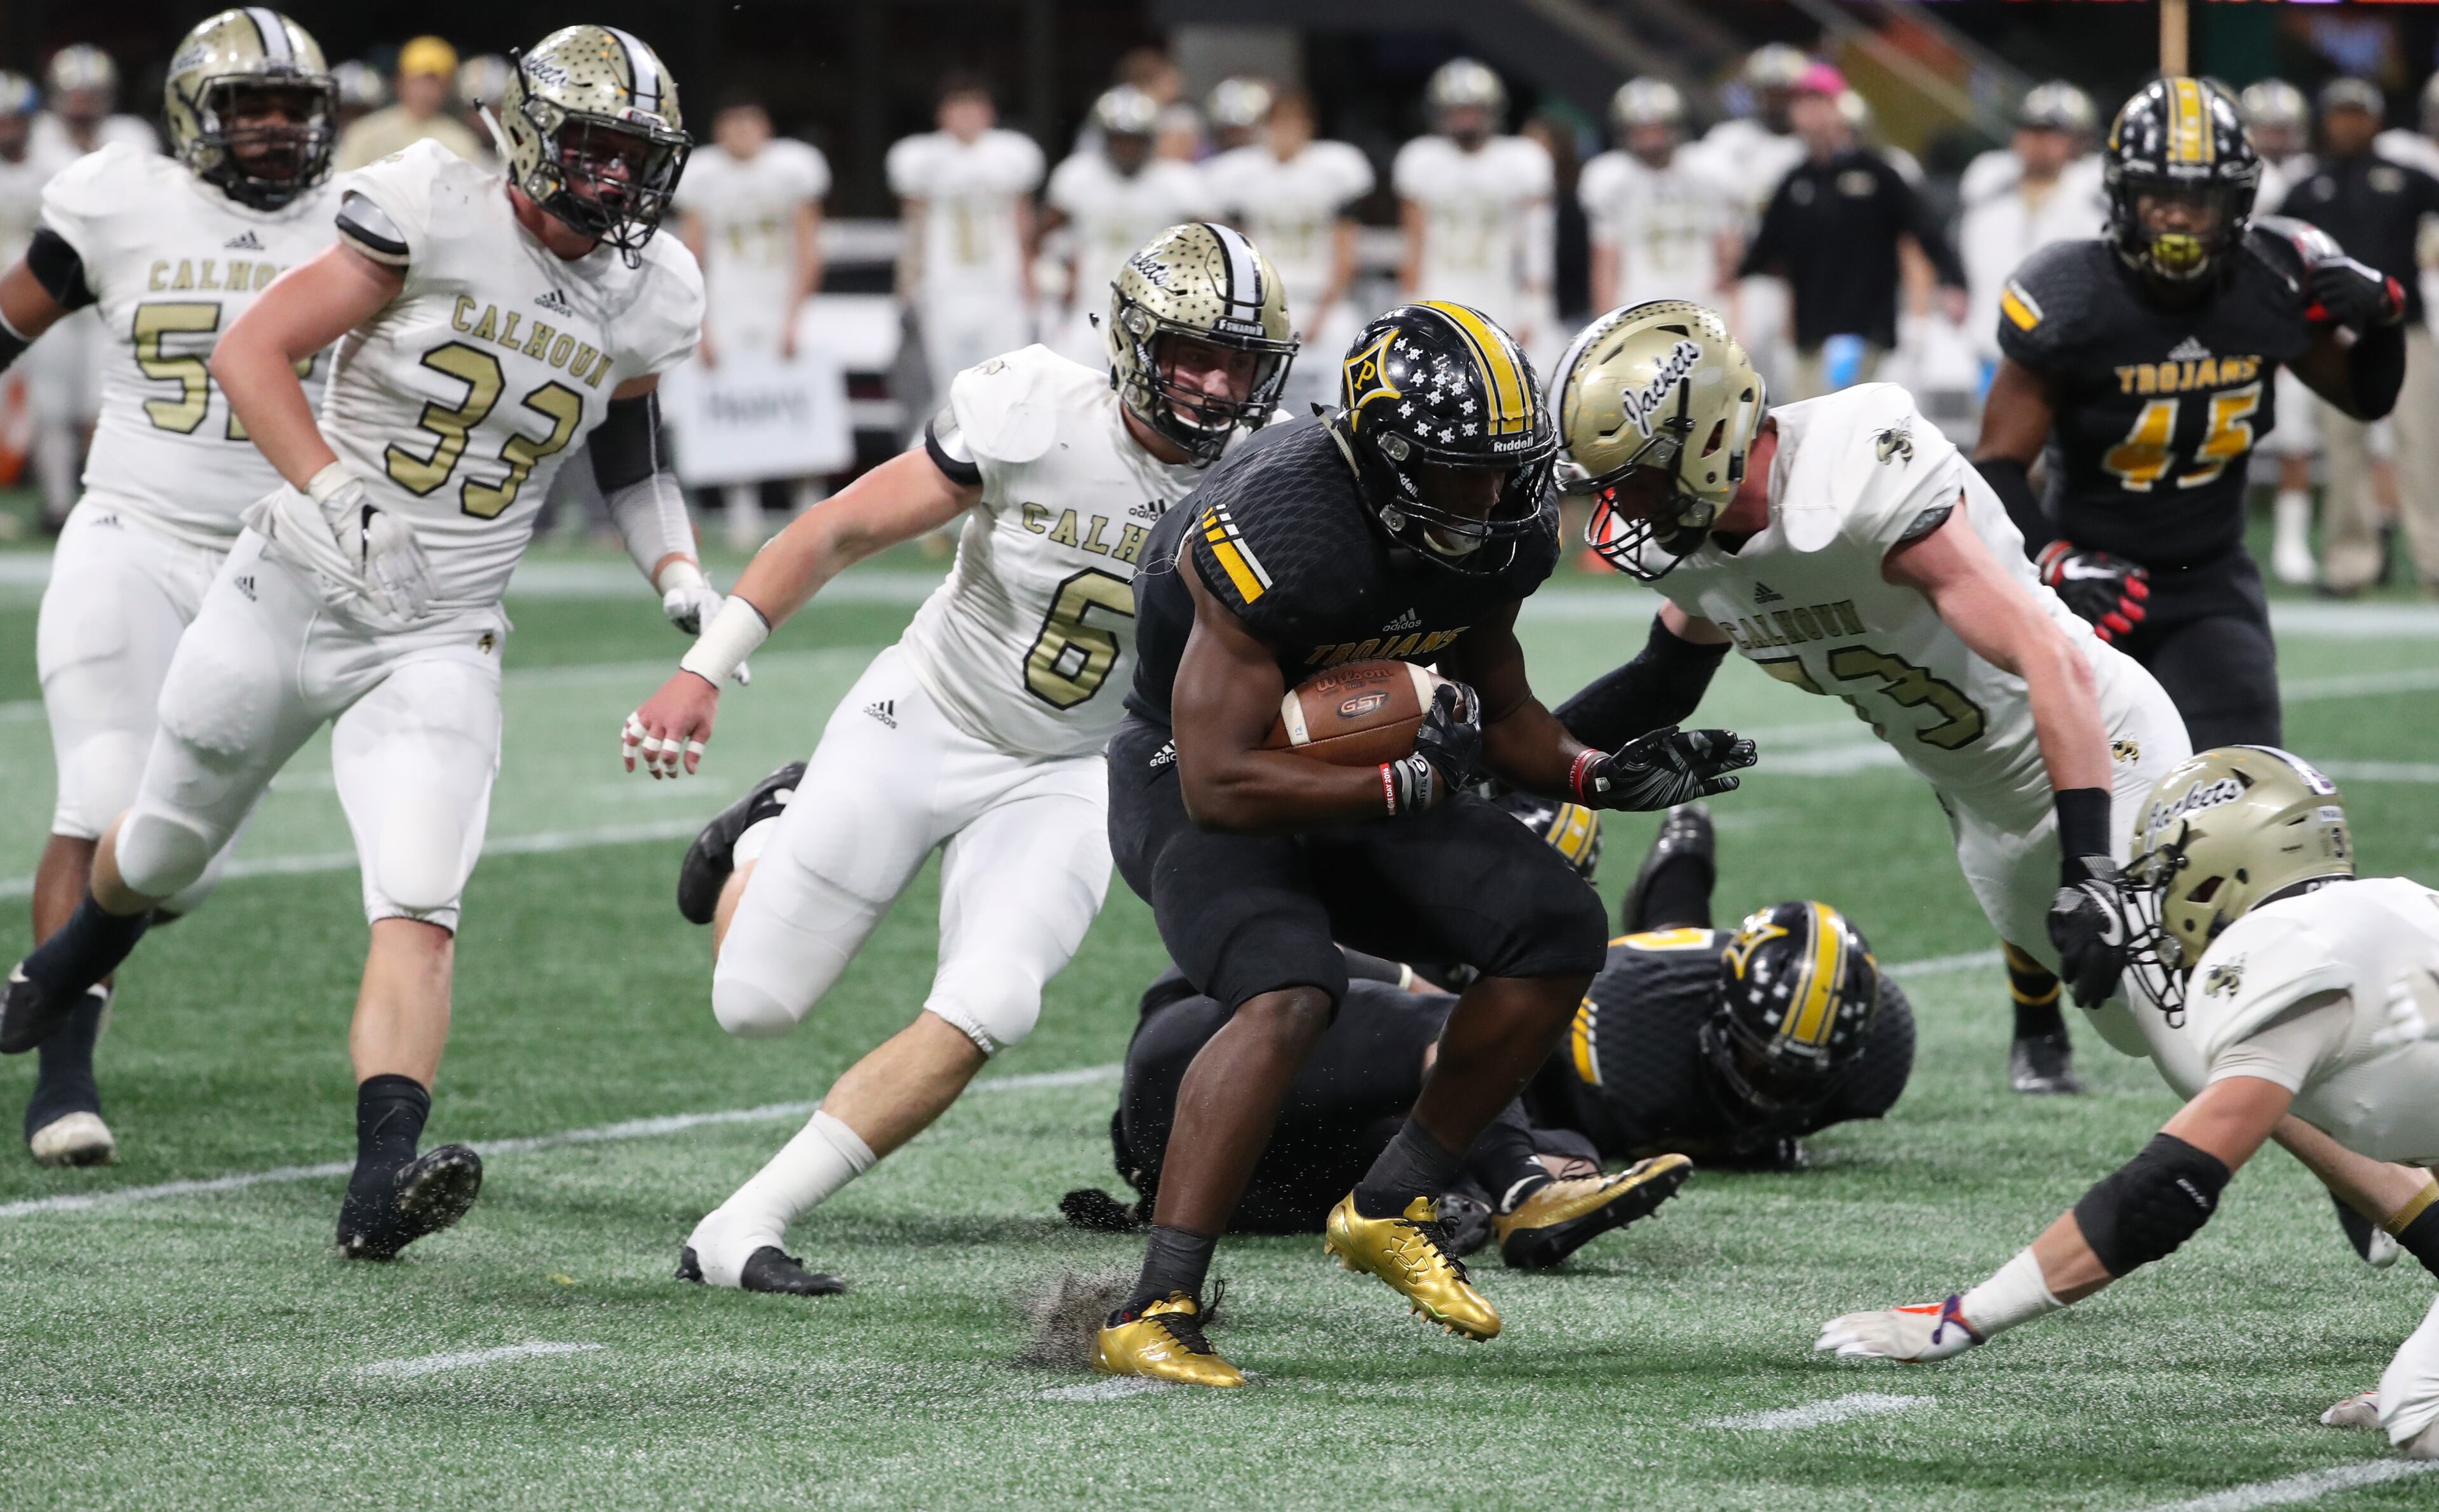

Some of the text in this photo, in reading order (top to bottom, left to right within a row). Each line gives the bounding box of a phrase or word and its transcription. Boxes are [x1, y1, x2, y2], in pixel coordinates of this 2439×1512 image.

[148, 258, 280, 291] CALHO
[452, 295, 614, 389] CALHOUN
[1354, 359, 1376, 390] P
[2114, 355, 2262, 394] TROJANS
[384, 340, 584, 520] 33
[1493, 437, 1534, 452] Riddell
[2101, 379, 2263, 492] 45
[1022, 502, 1151, 565] CALH
[1129, 507, 1159, 522] adid
[1023, 566, 1135, 711] 6
[1383, 619, 1422, 632] adidas
[1719, 599, 1867, 650] CALHOUN
[1303, 626, 1471, 667] TROJANS
[1340, 693, 1387, 714] GST
[1383, 767, 1391, 783] 2016
